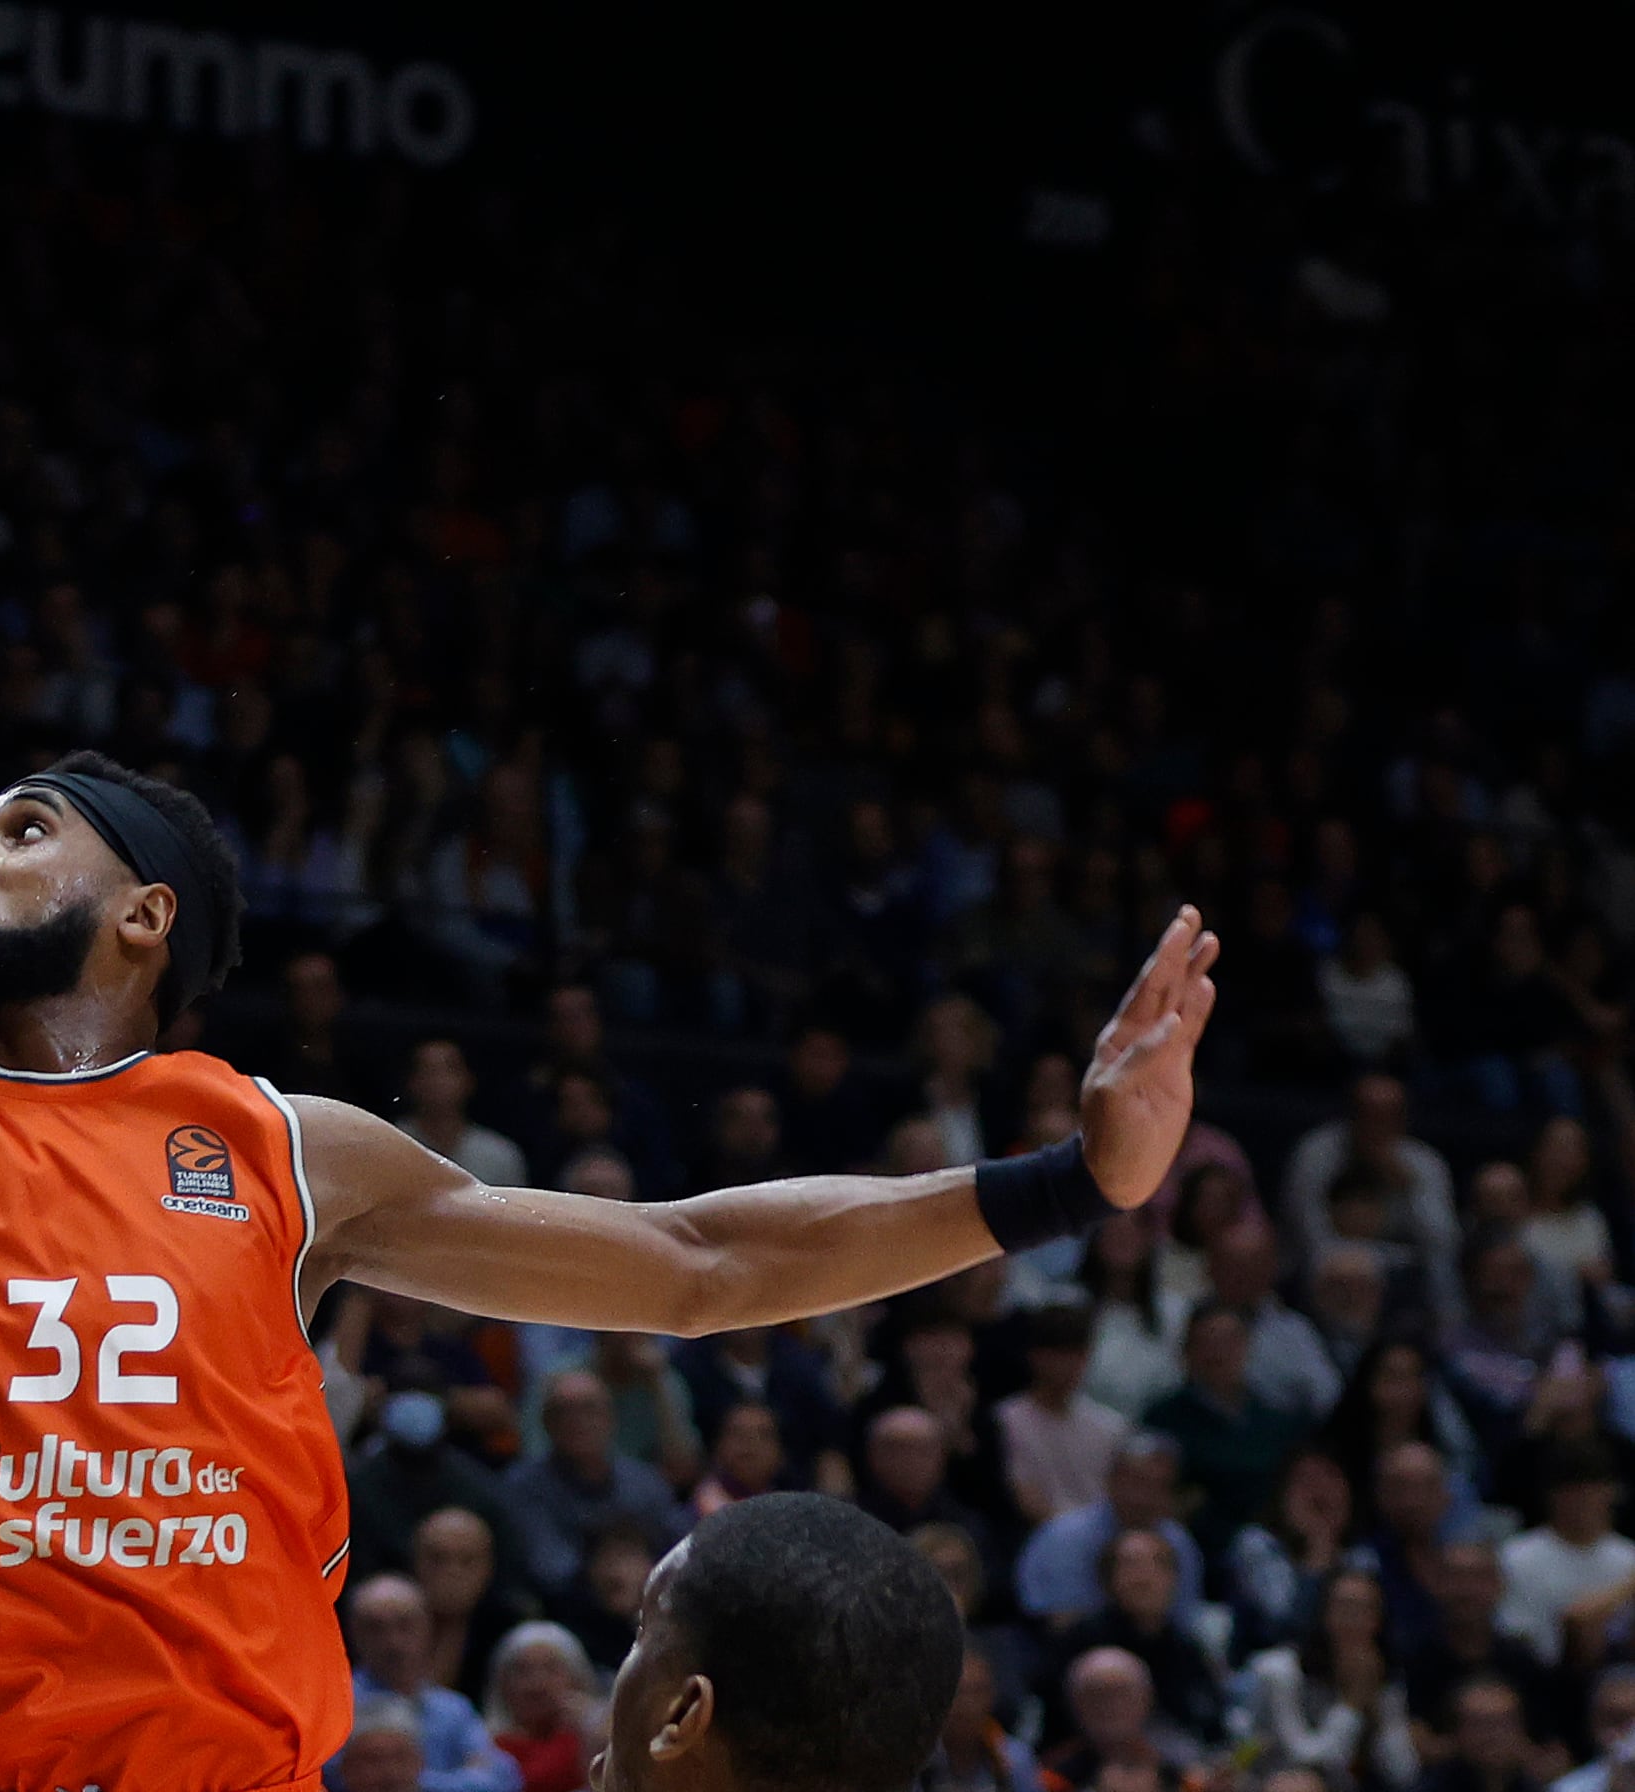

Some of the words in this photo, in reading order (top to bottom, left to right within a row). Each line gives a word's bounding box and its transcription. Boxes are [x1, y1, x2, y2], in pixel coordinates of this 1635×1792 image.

[175, 1171, 228, 1182] TURKISH
[161, 1195, 249, 1221] oneteam
[7, 1274, 180, 1404] 32
